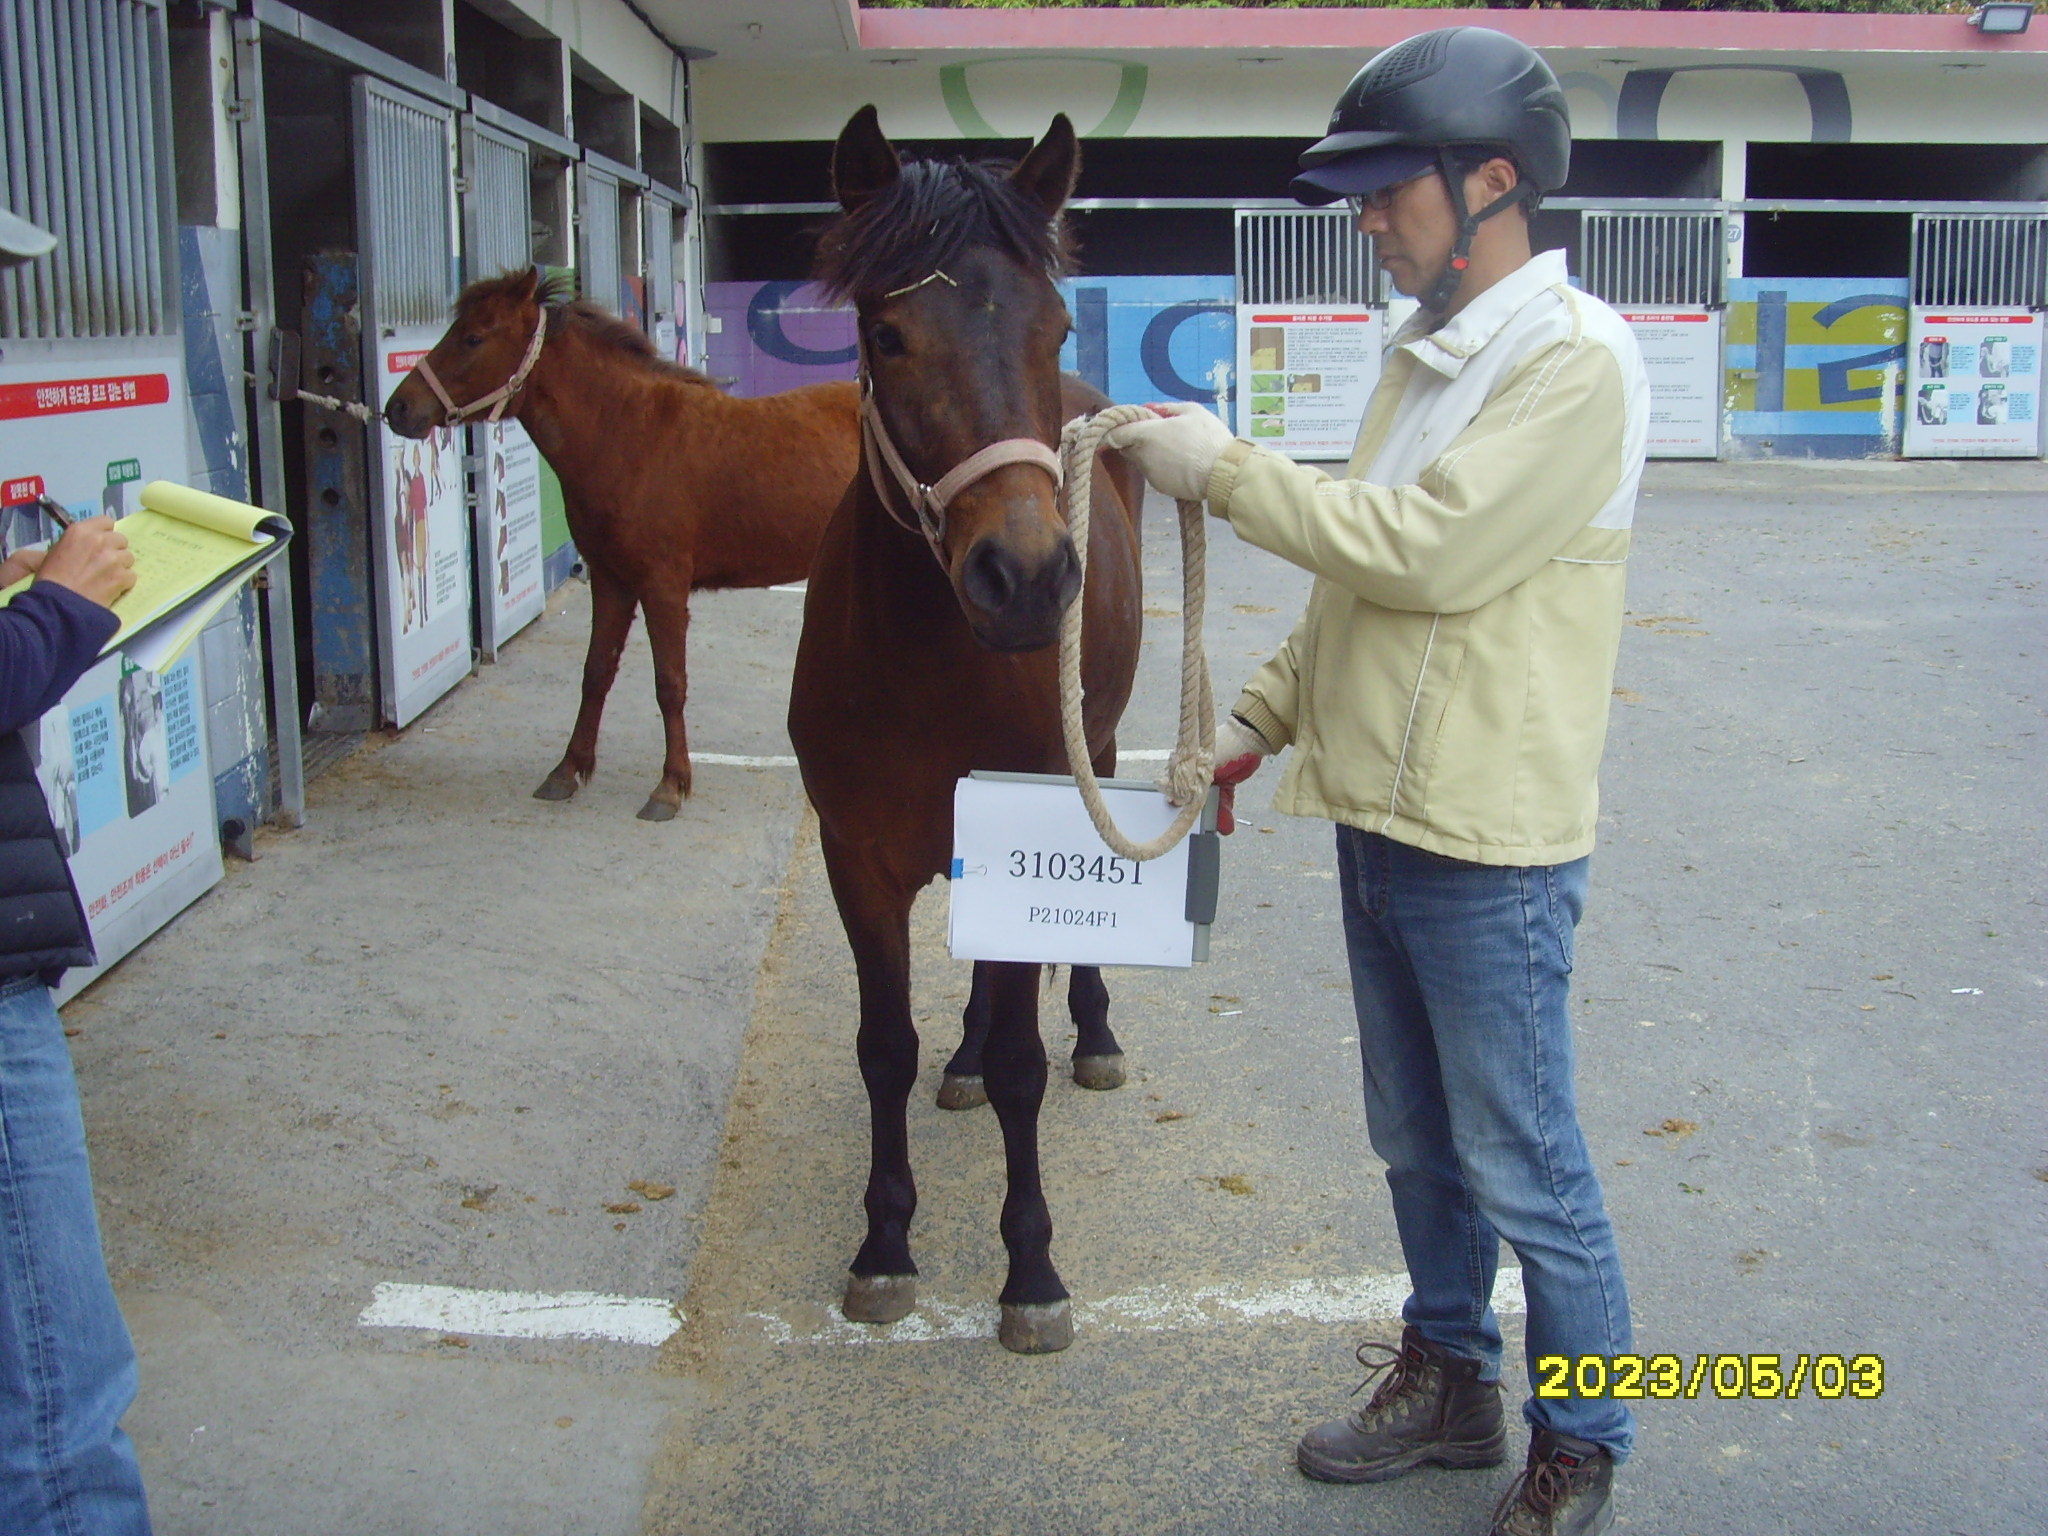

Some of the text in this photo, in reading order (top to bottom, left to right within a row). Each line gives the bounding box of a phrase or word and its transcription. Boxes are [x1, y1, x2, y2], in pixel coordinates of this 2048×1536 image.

[1727, 228, 1740, 239] 27
[36, 380, 137, 409] 안전하게 유도용 로프 잡는 방법
[10, 480, 36, 500] 잘못된 예
[1008, 849, 1143, 886] 3103451
[1028, 906, 1118, 928] P21024F1
